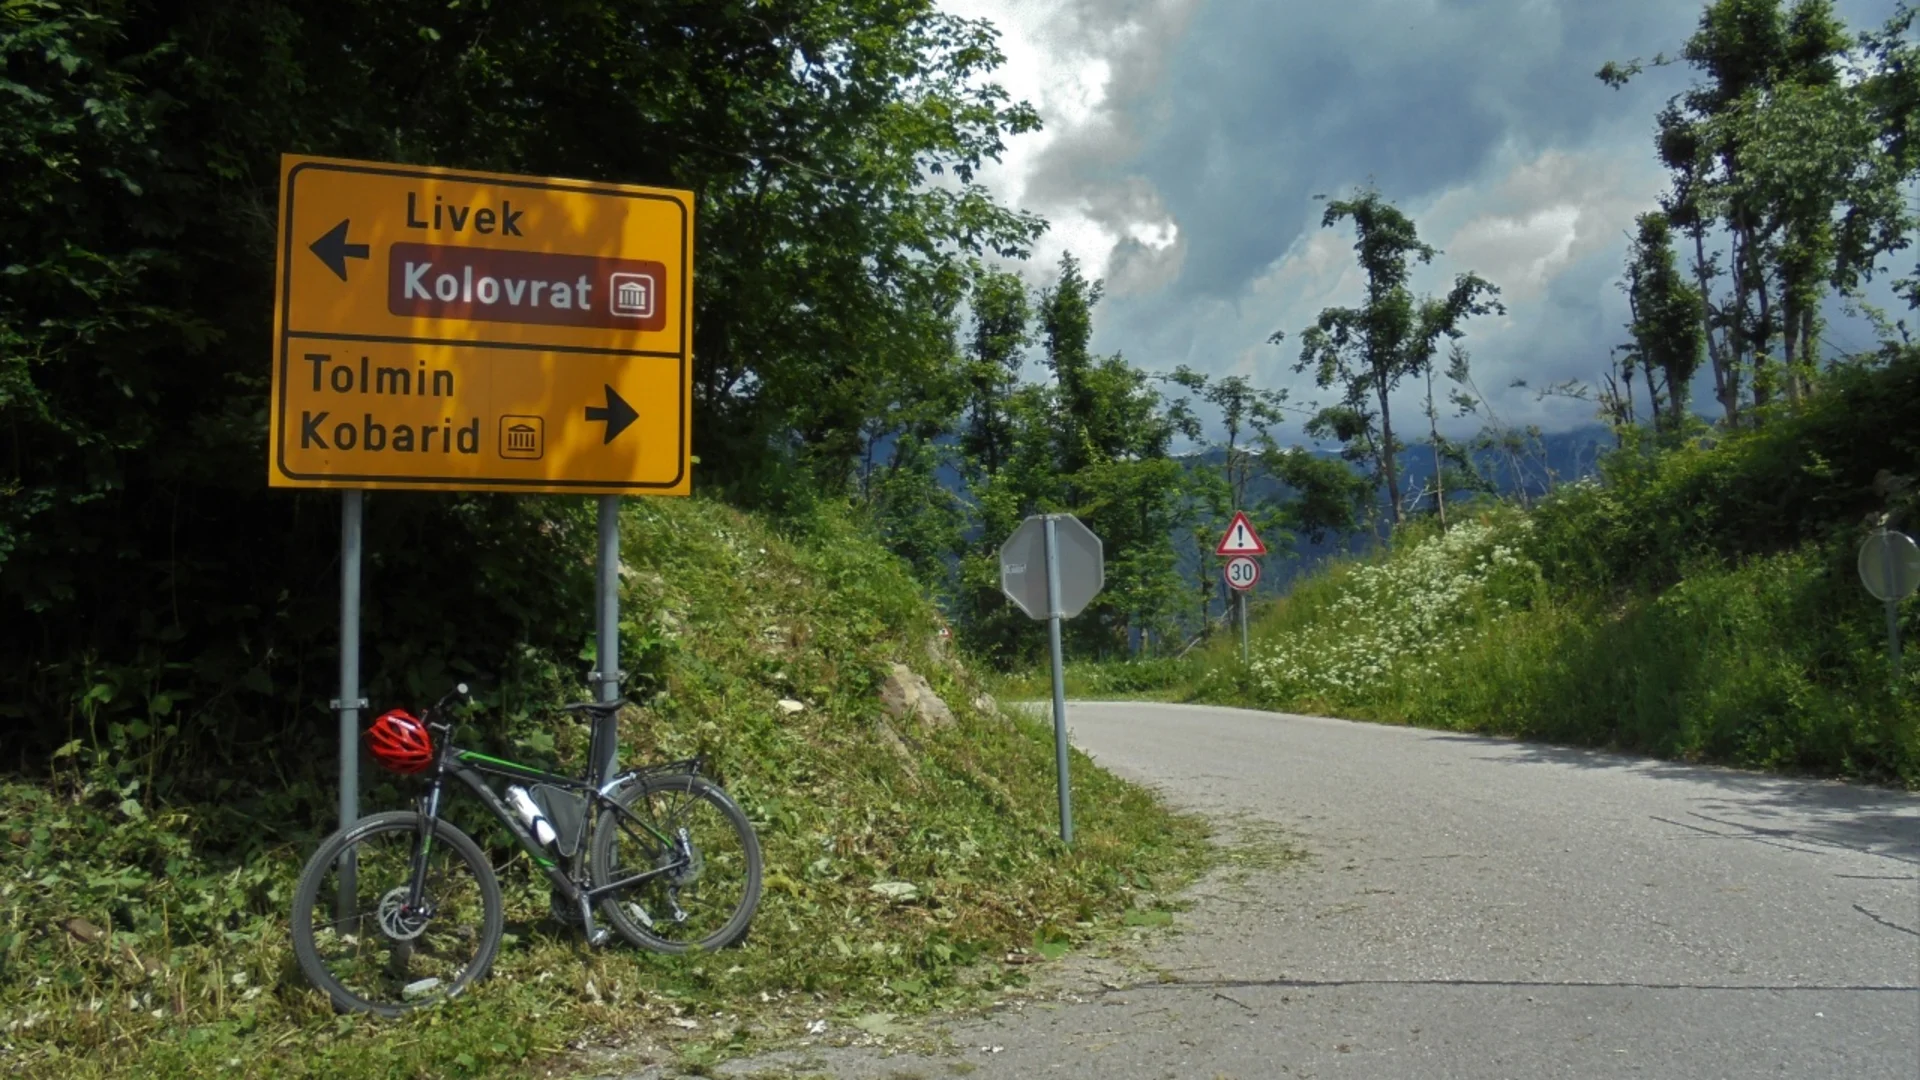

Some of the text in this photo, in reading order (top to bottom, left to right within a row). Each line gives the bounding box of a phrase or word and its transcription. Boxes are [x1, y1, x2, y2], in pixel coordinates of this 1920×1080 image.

[406, 191, 524, 236] Livek
[403, 262, 592, 310] Kolovrat
[304, 354, 454, 397] Tolmin
[301, 411, 479, 454] Kobarid
[1231, 563, 1253, 581] 30
